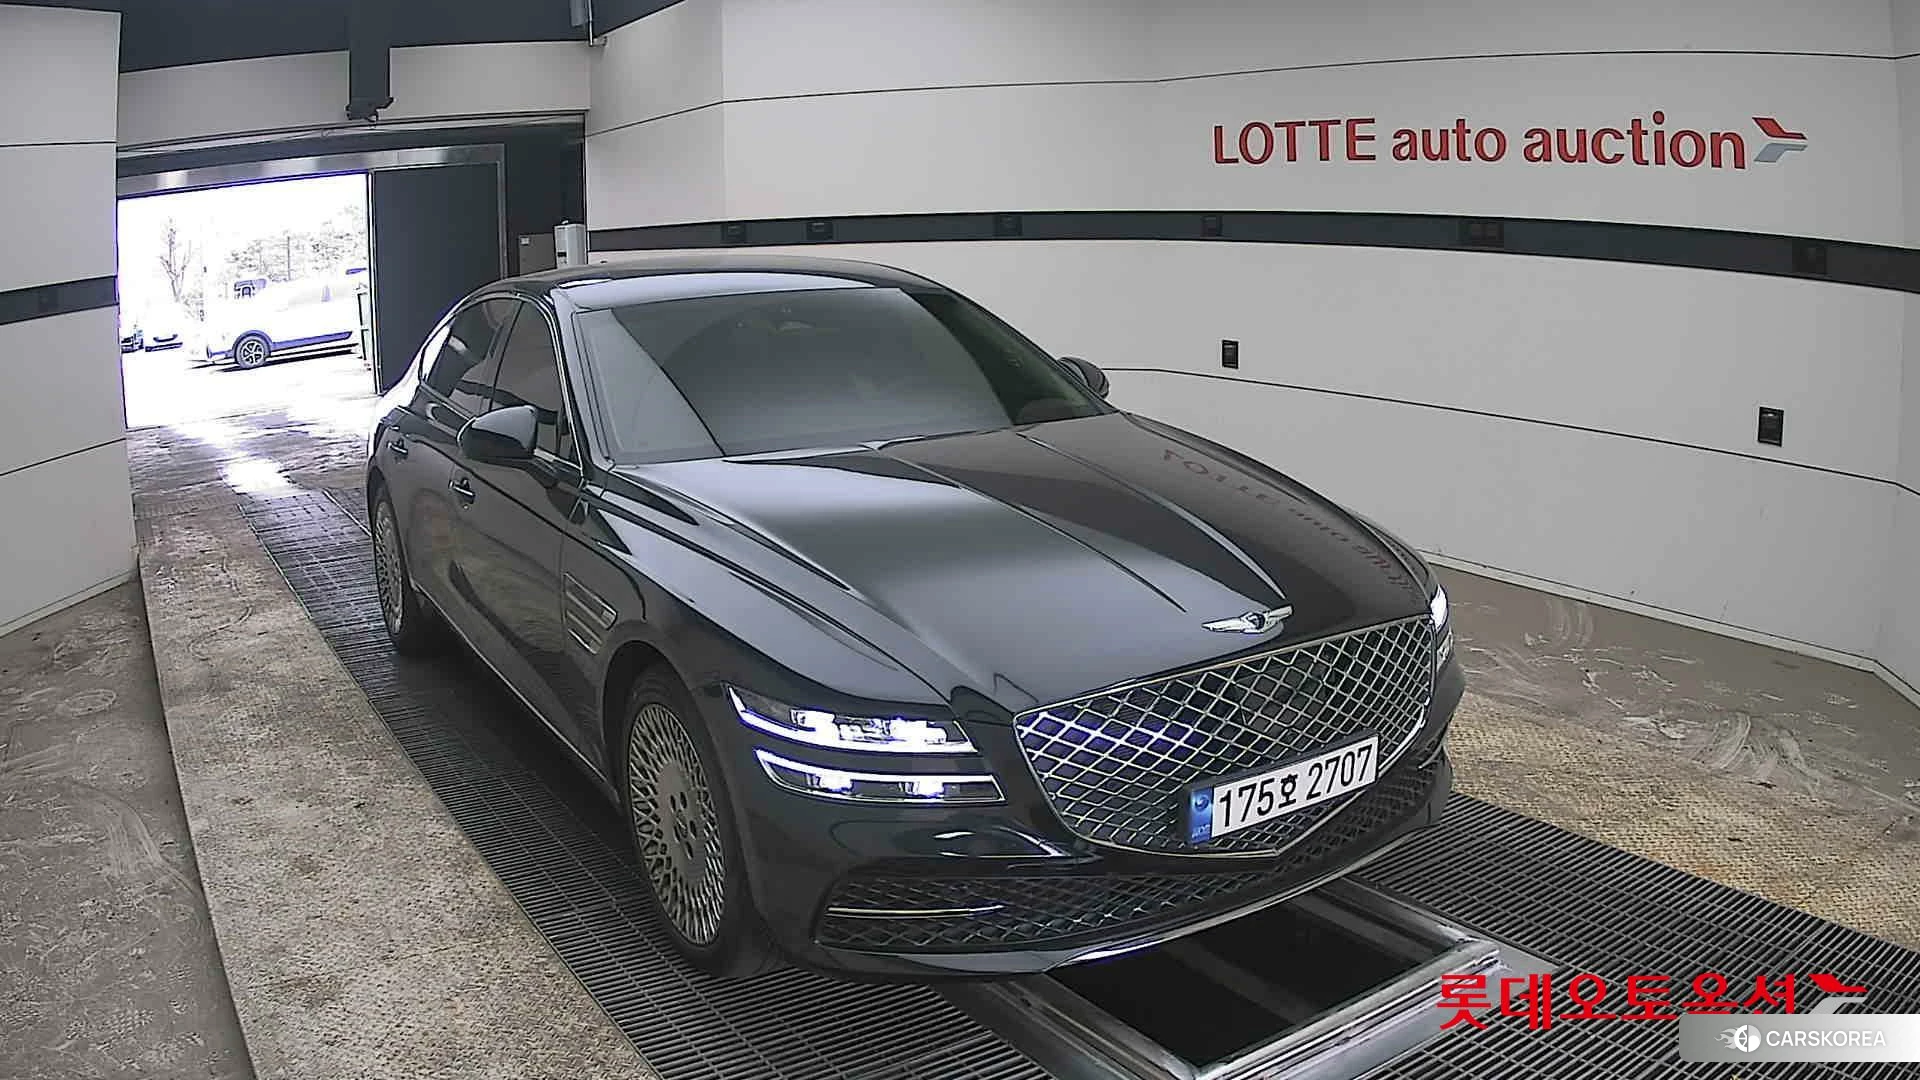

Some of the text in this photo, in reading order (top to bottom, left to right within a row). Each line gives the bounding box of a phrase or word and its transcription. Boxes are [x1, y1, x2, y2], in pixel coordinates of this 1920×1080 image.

[1213, 110, 1746, 169] LOTTE auto auction
[1306, 743, 1374, 801] 2707
